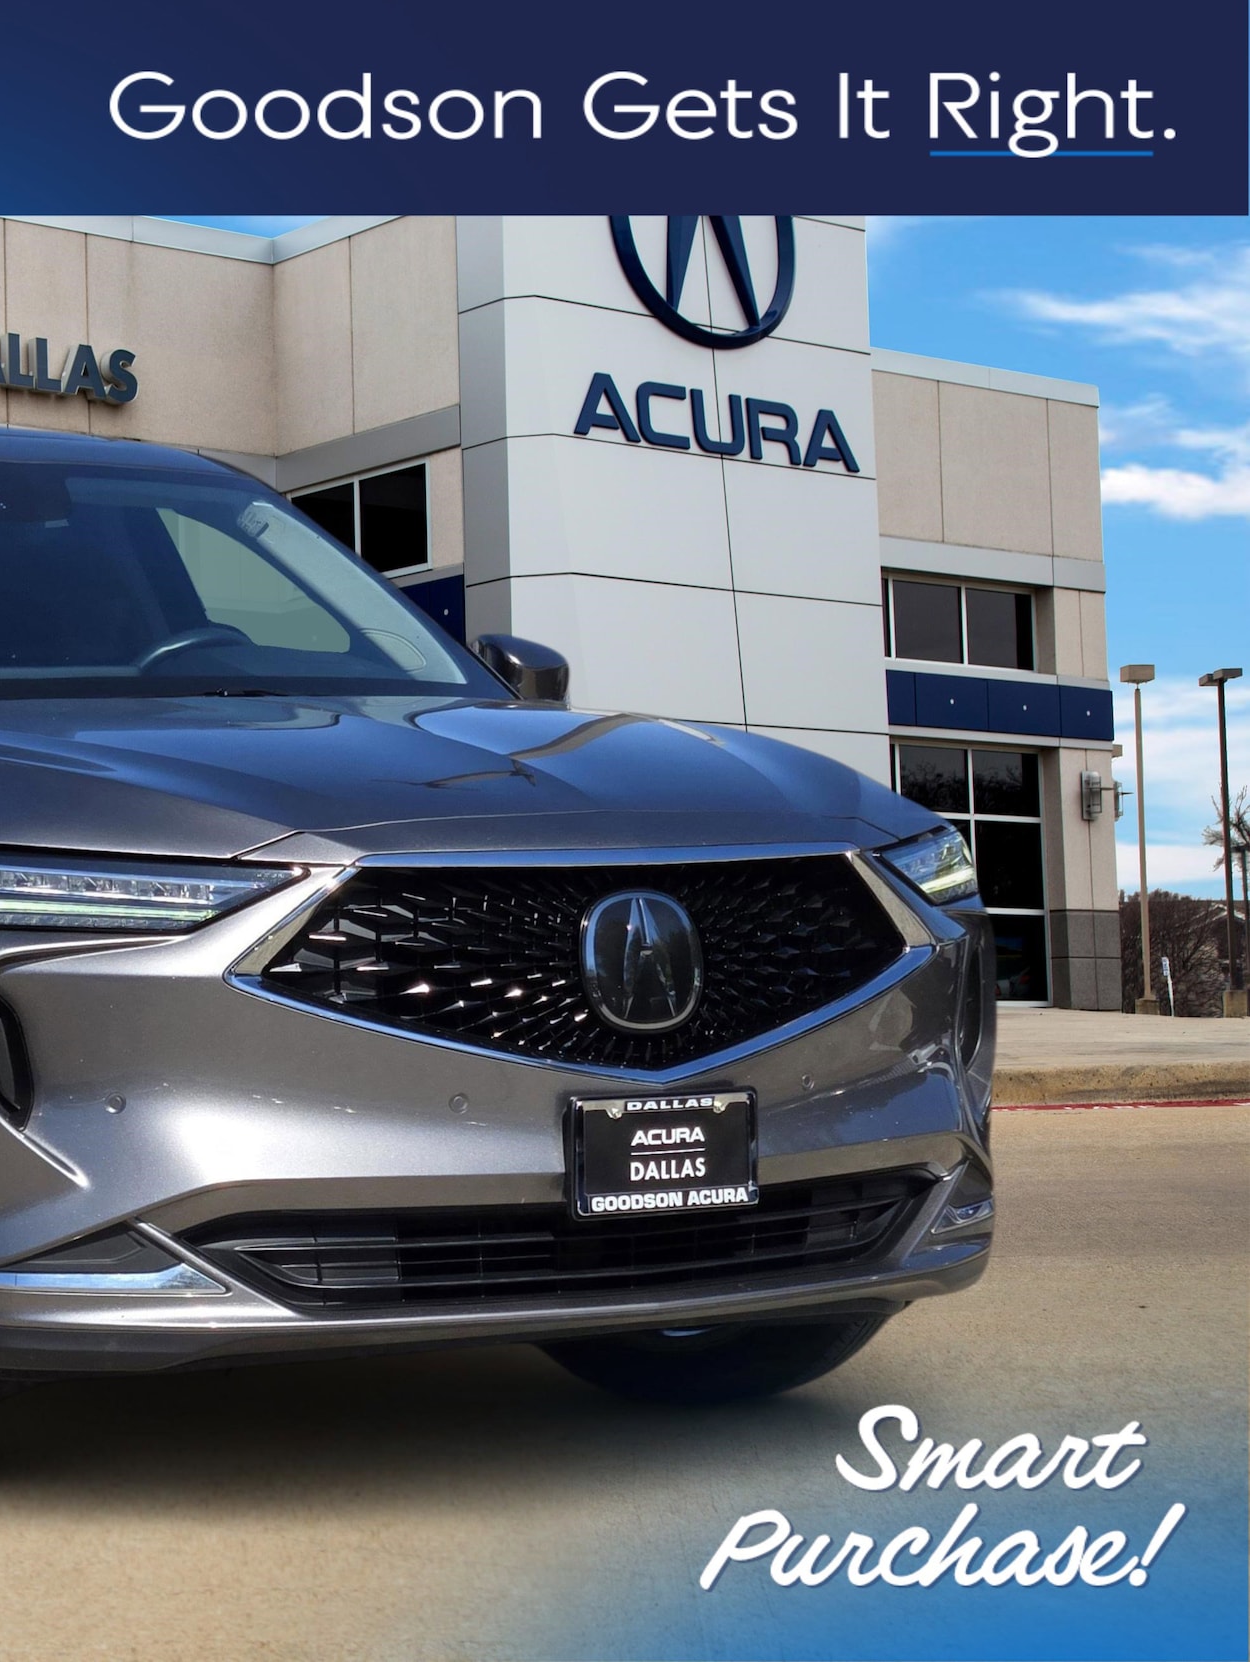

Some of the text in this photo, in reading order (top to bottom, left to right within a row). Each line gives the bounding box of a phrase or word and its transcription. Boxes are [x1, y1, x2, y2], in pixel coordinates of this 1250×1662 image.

[573, 372, 860, 473] ACURA
[626, 1097, 713, 1111] DALLAS
[630, 1126, 706, 1147] ACURA
[629, 1157, 706, 1182] DALLAS
[591, 1187, 749, 1213] GOODSON ACURA
